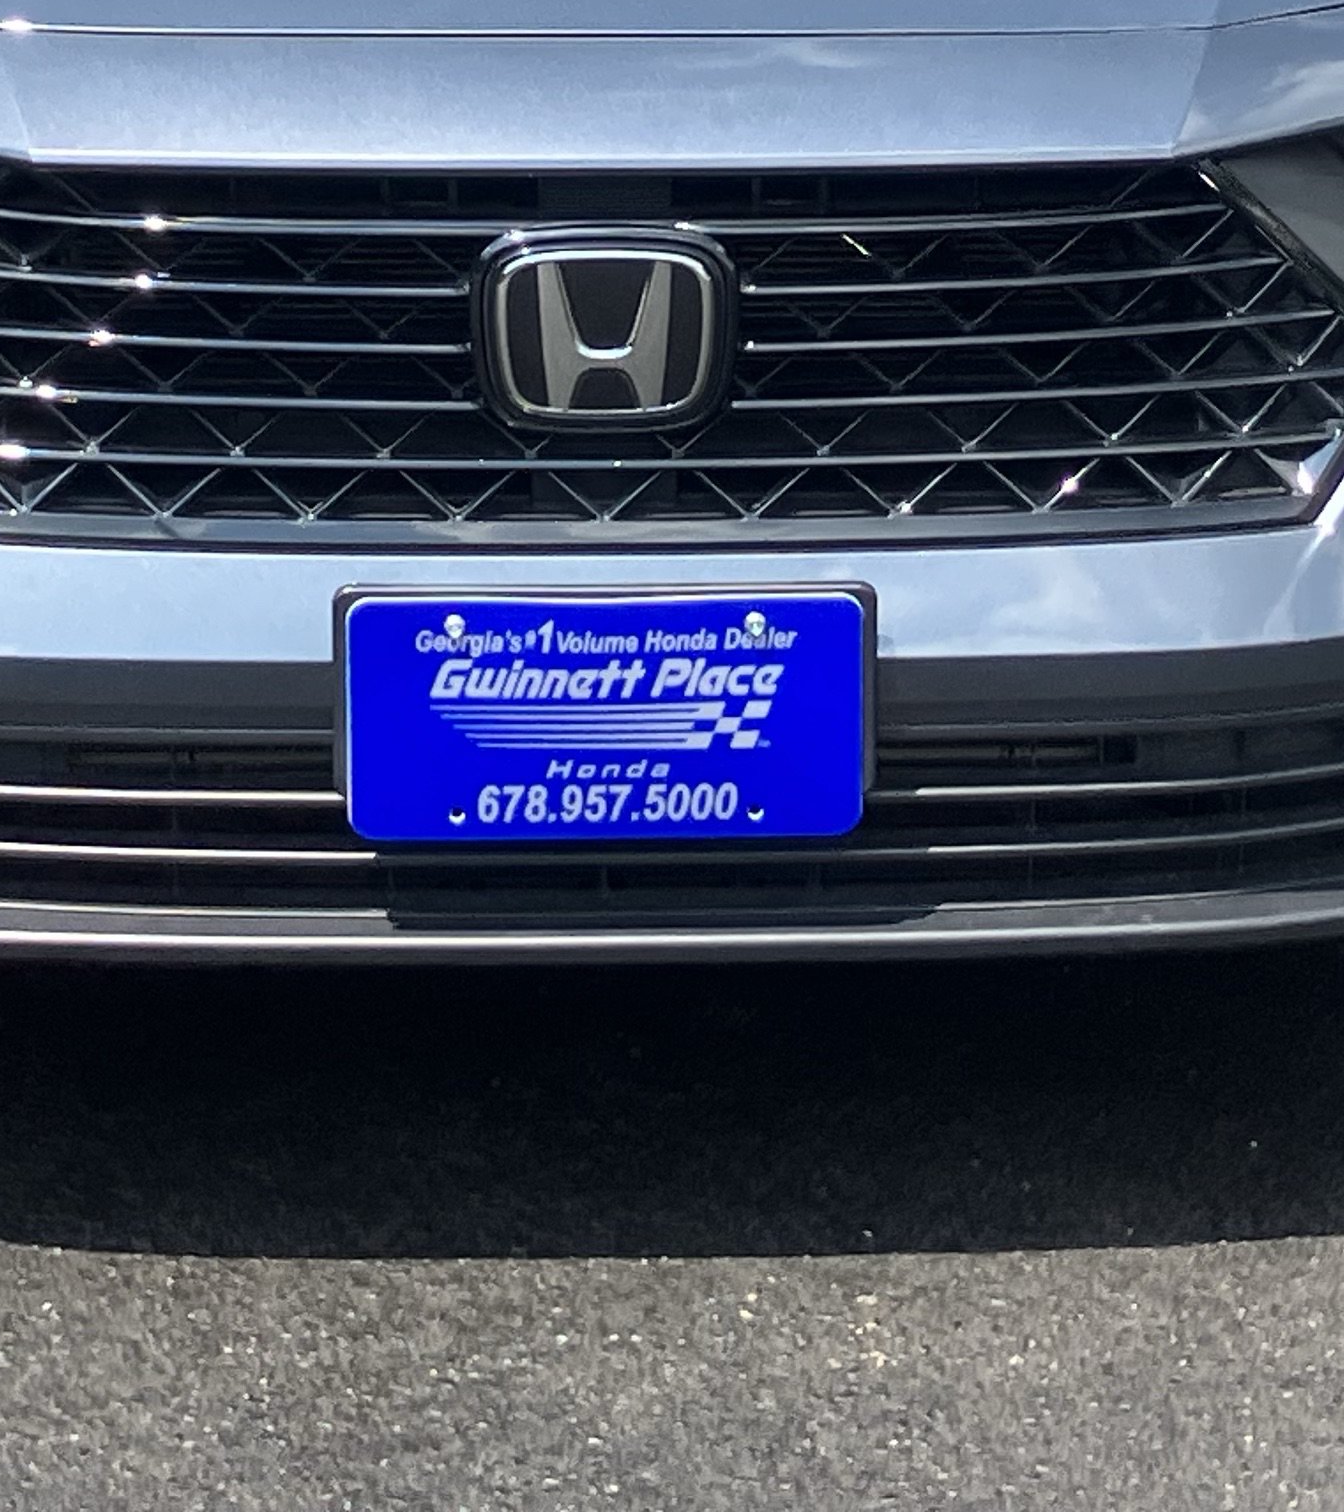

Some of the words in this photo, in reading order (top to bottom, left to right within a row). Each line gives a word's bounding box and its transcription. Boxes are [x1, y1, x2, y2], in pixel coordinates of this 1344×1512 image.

[415, 629, 523, 658] Georgia's
[556, 630, 639, 654] Volume
[643, 628, 718, 653] Honda
[723, 626, 798, 651] Dealer
[429, 659, 646, 699] Gwinnett
[650, 657, 785, 698] Place
[546, 759, 670, 779] Honda
[477, 782, 739, 823] 678.957.5000
